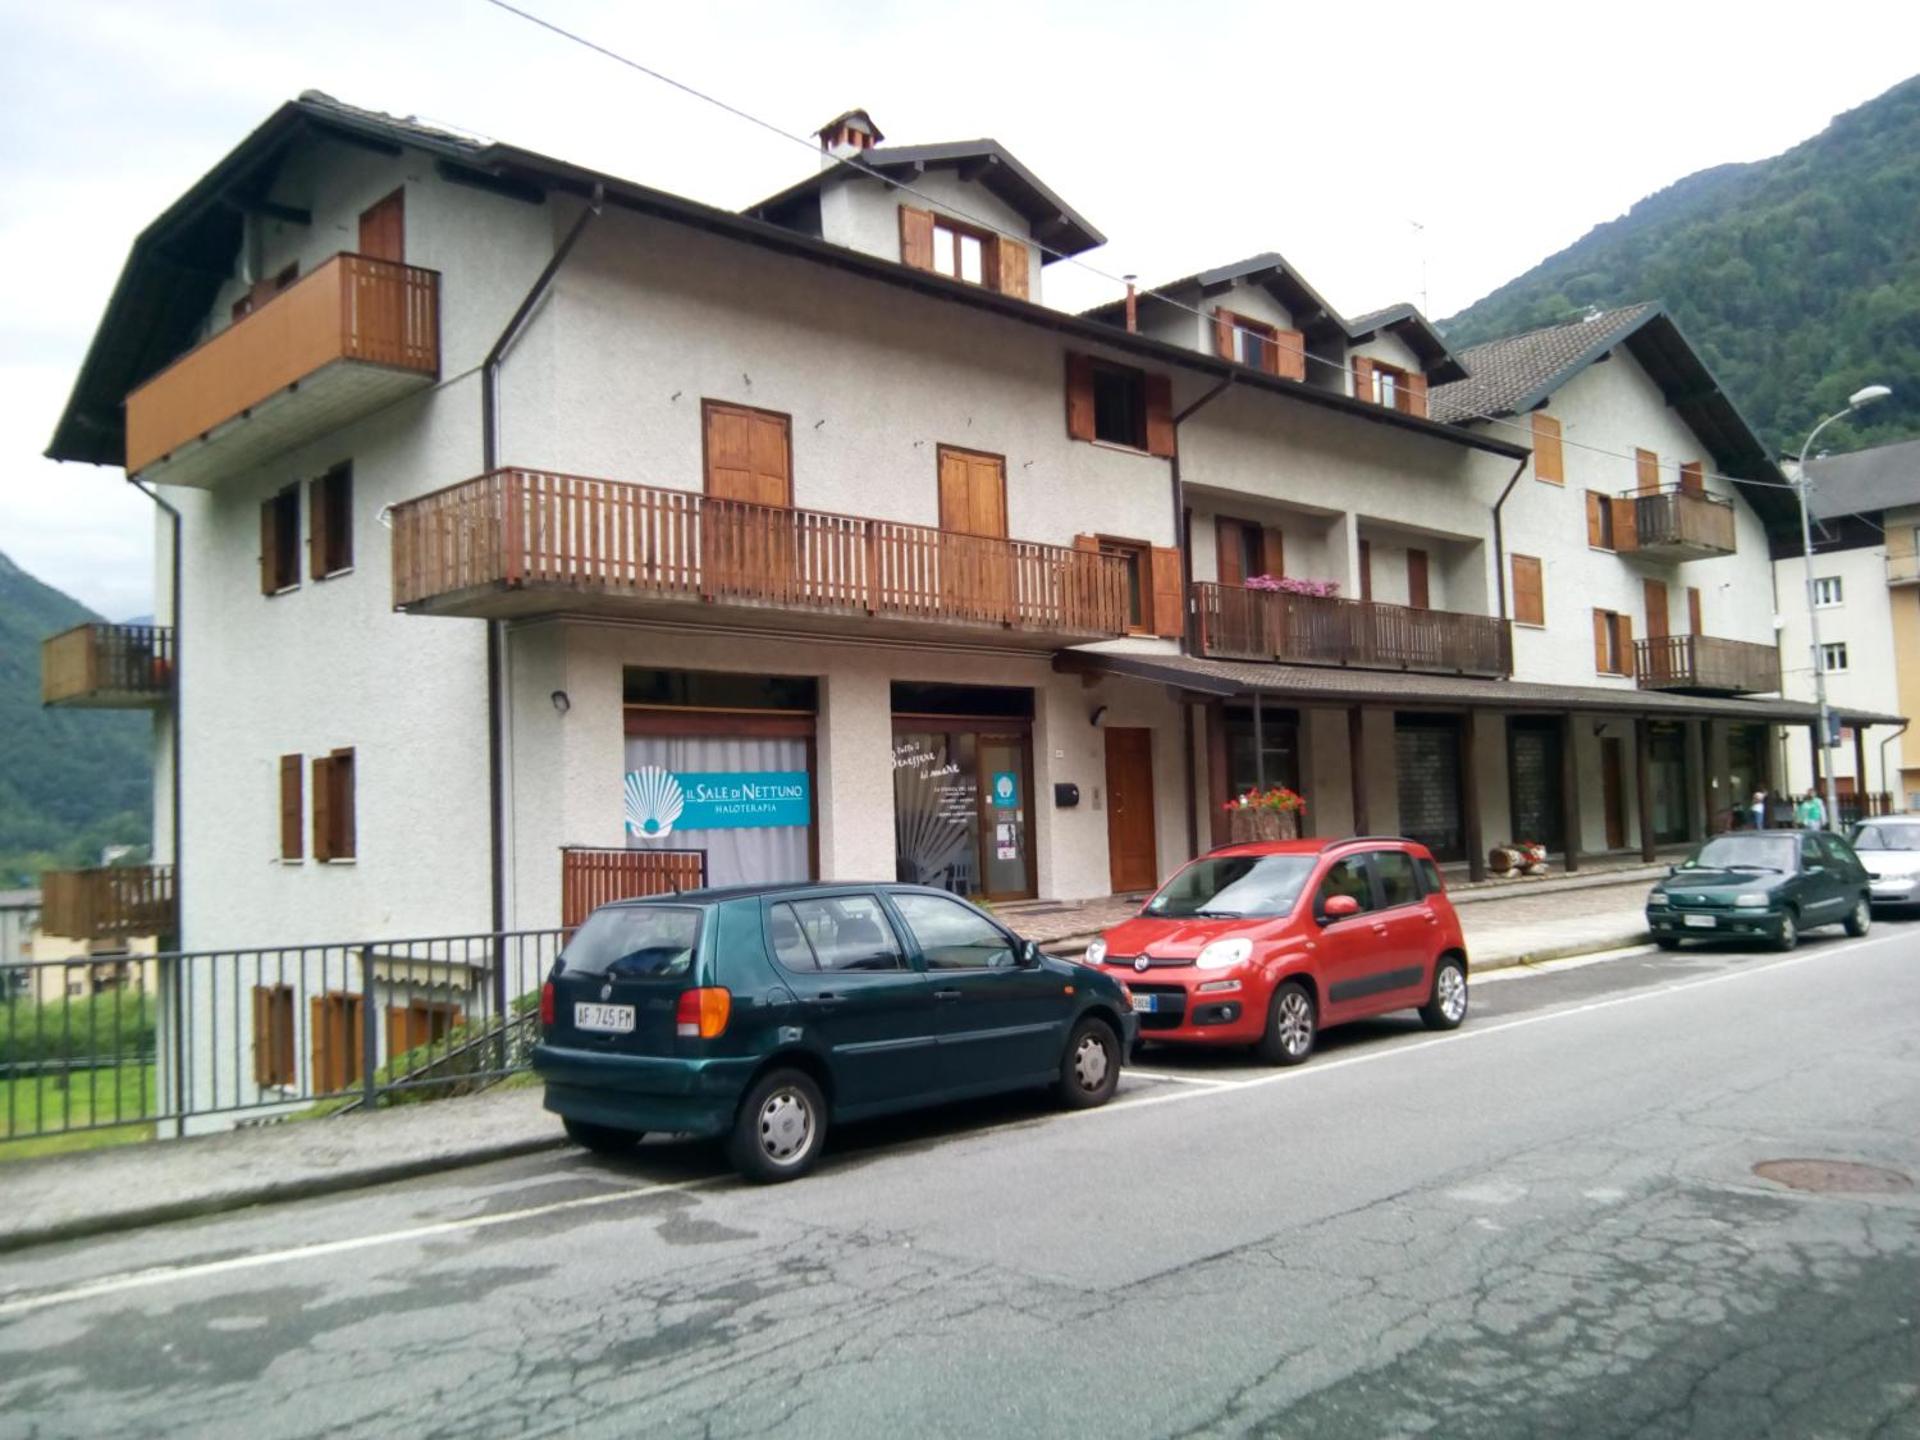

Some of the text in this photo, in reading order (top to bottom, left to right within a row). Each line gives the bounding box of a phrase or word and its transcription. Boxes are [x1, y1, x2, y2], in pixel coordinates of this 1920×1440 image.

[686, 783, 803, 802] IL SALE DI NETTUNO
[715, 803, 777, 814] HALOTERAPIA
[578, 1006, 633, 1028] AF 745 FM
